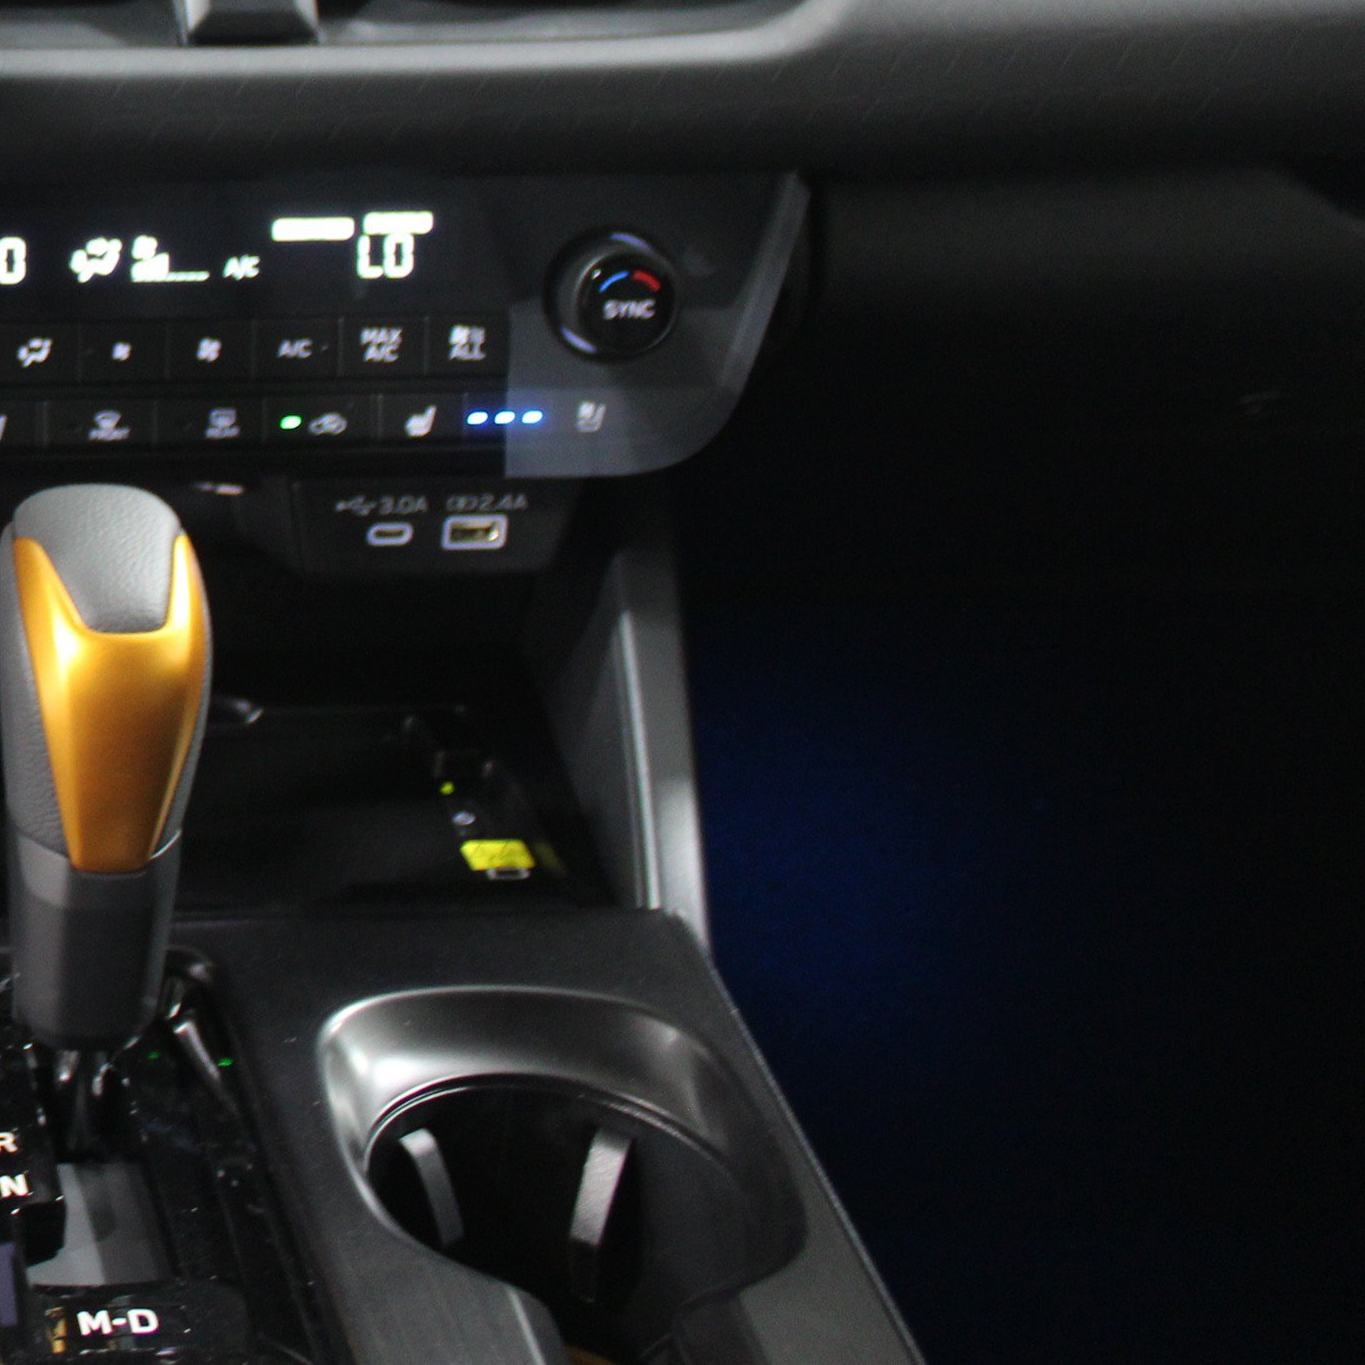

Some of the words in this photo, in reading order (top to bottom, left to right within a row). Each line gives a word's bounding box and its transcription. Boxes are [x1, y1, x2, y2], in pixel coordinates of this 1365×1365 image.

[356, 232, 415, 279] LO
[223, 255, 259, 280] A/C
[602, 299, 657, 321] SYNC
[360, 326, 403, 344] MAX
[278, 339, 313, 359] A/C
[363, 343, 400, 363] A/C
[449, 342, 486, 361] ALL
[378, 494, 429, 514] 3.0A
[476, 493, 529, 512] 2.4A
[76, 1307, 160, 1336] M-D
